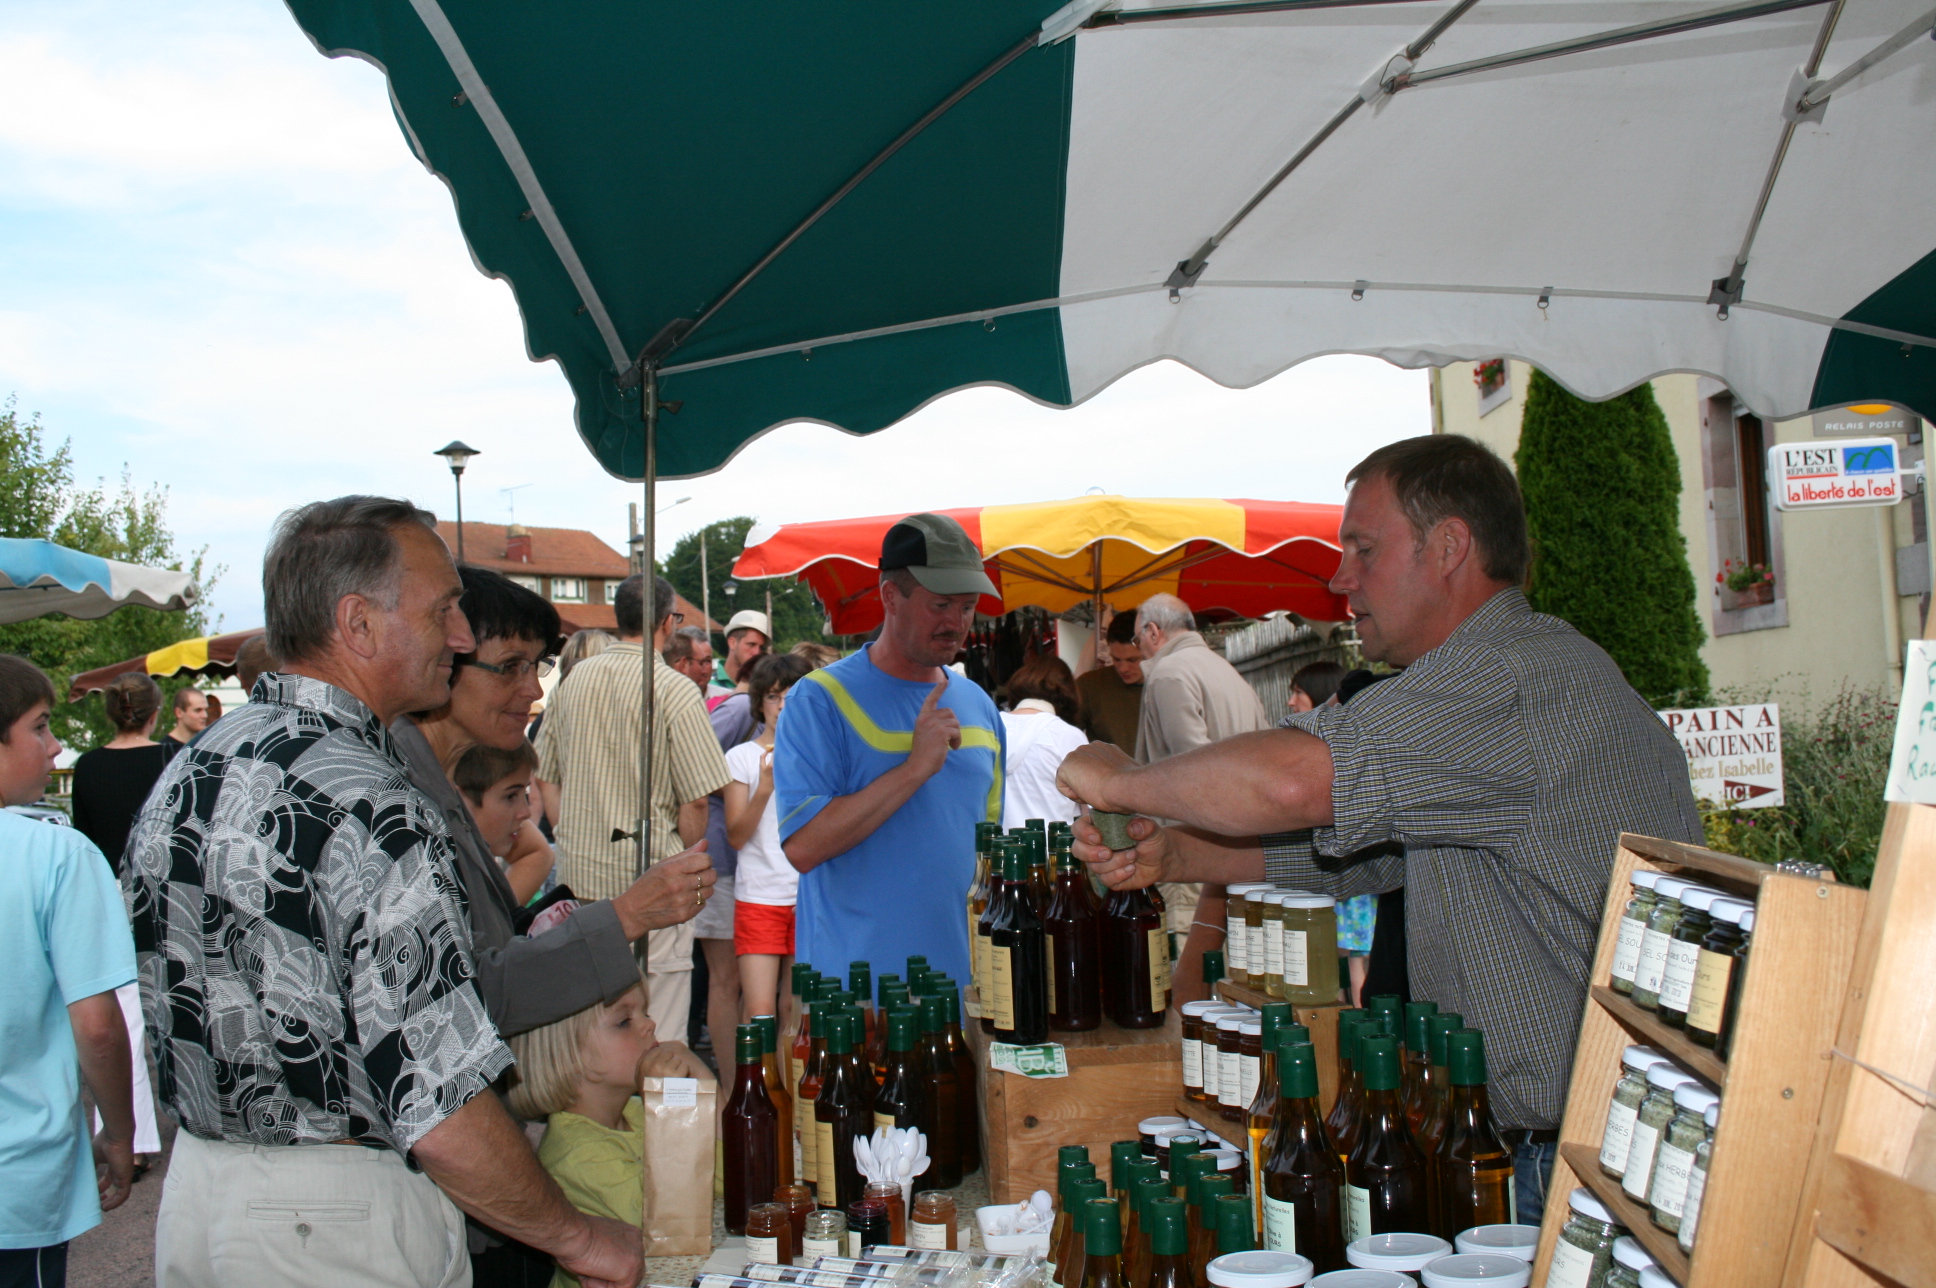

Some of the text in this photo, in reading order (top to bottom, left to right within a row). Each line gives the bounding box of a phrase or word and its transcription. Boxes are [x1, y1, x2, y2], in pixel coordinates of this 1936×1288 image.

[1825, 420, 1905, 431] RELAIS POSTE
[1785, 448, 1837, 467] L'EST
[1787, 478, 1896, 503] la liberté de l'est
[1666, 706, 1775, 734] PAIN A
[1689, 758, 1775, 780] hez Isabelle
[1725, 785, 1752, 801] ICI
